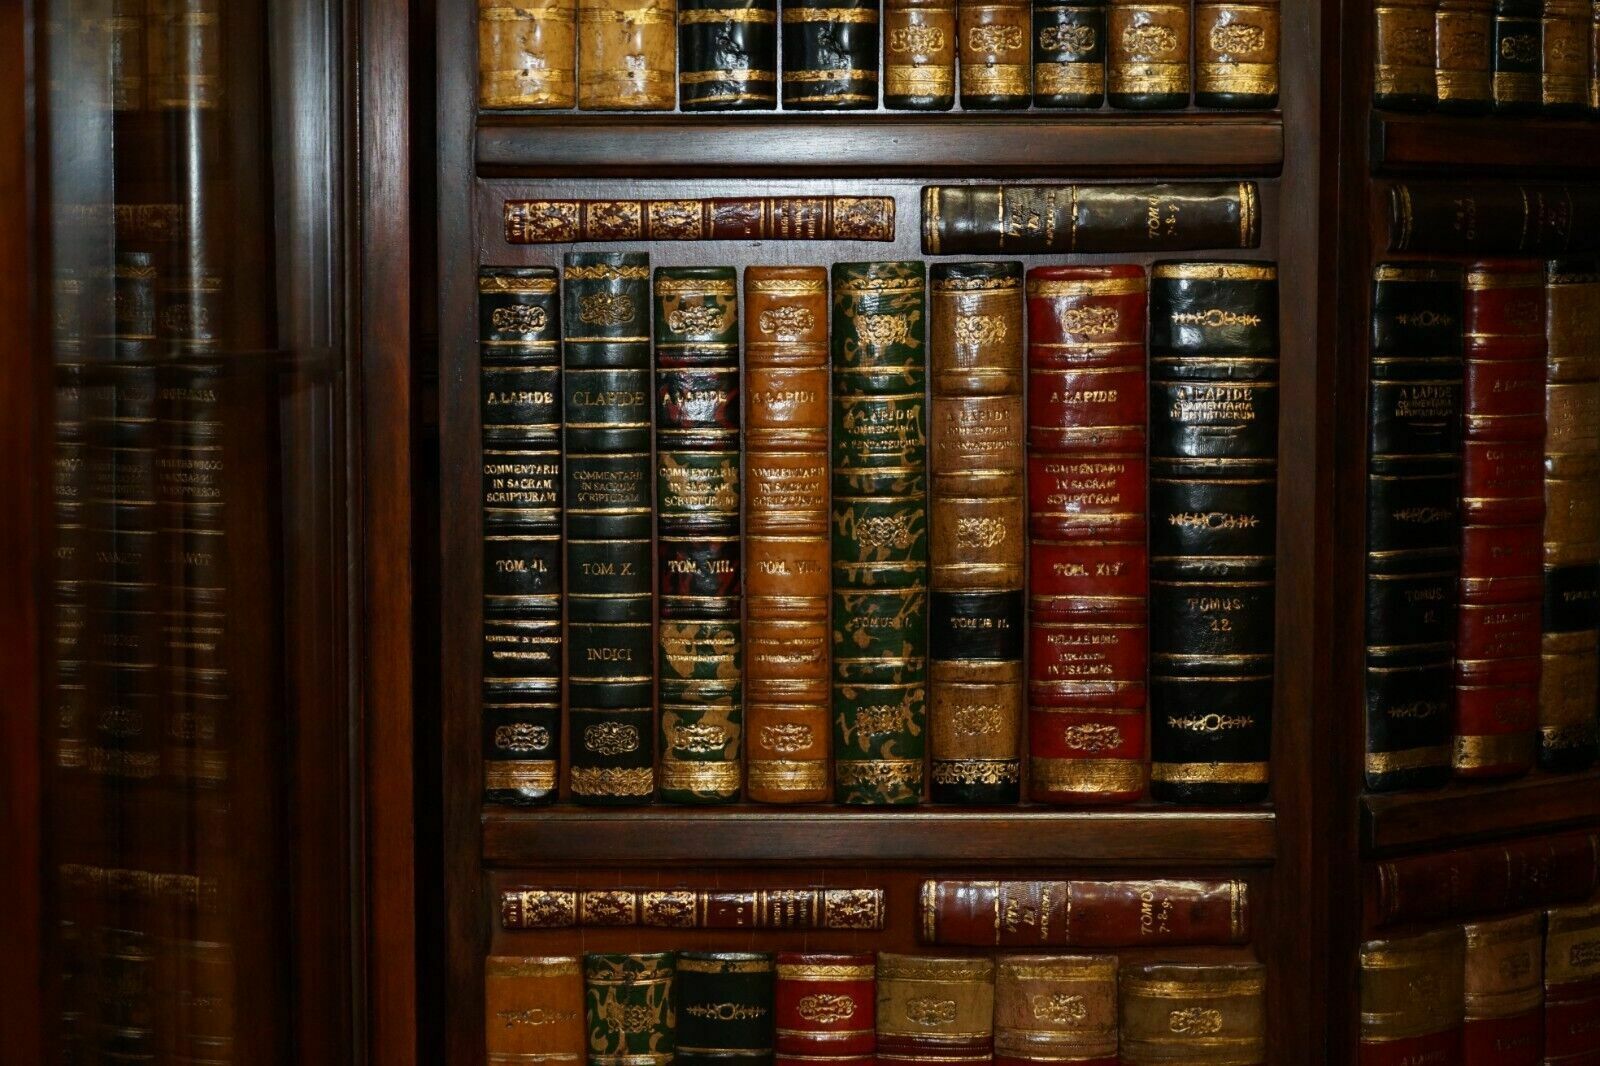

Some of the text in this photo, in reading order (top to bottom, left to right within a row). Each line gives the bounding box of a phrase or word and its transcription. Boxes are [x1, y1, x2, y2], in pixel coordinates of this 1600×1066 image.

[501, 391, 554, 405] LAPIDE
[1063, 389, 1118, 403] LAPIDE
[1195, 386, 1253, 401] LAPIDE
[484, 464, 559, 475] COMMENTARII
[493, 478, 553, 490] IN SACRAM
[486, 491, 557, 503] SCRIPTURAM
[1210, 618, 1233, 632] 12
[1141, 890, 1154, 936] TOMO
